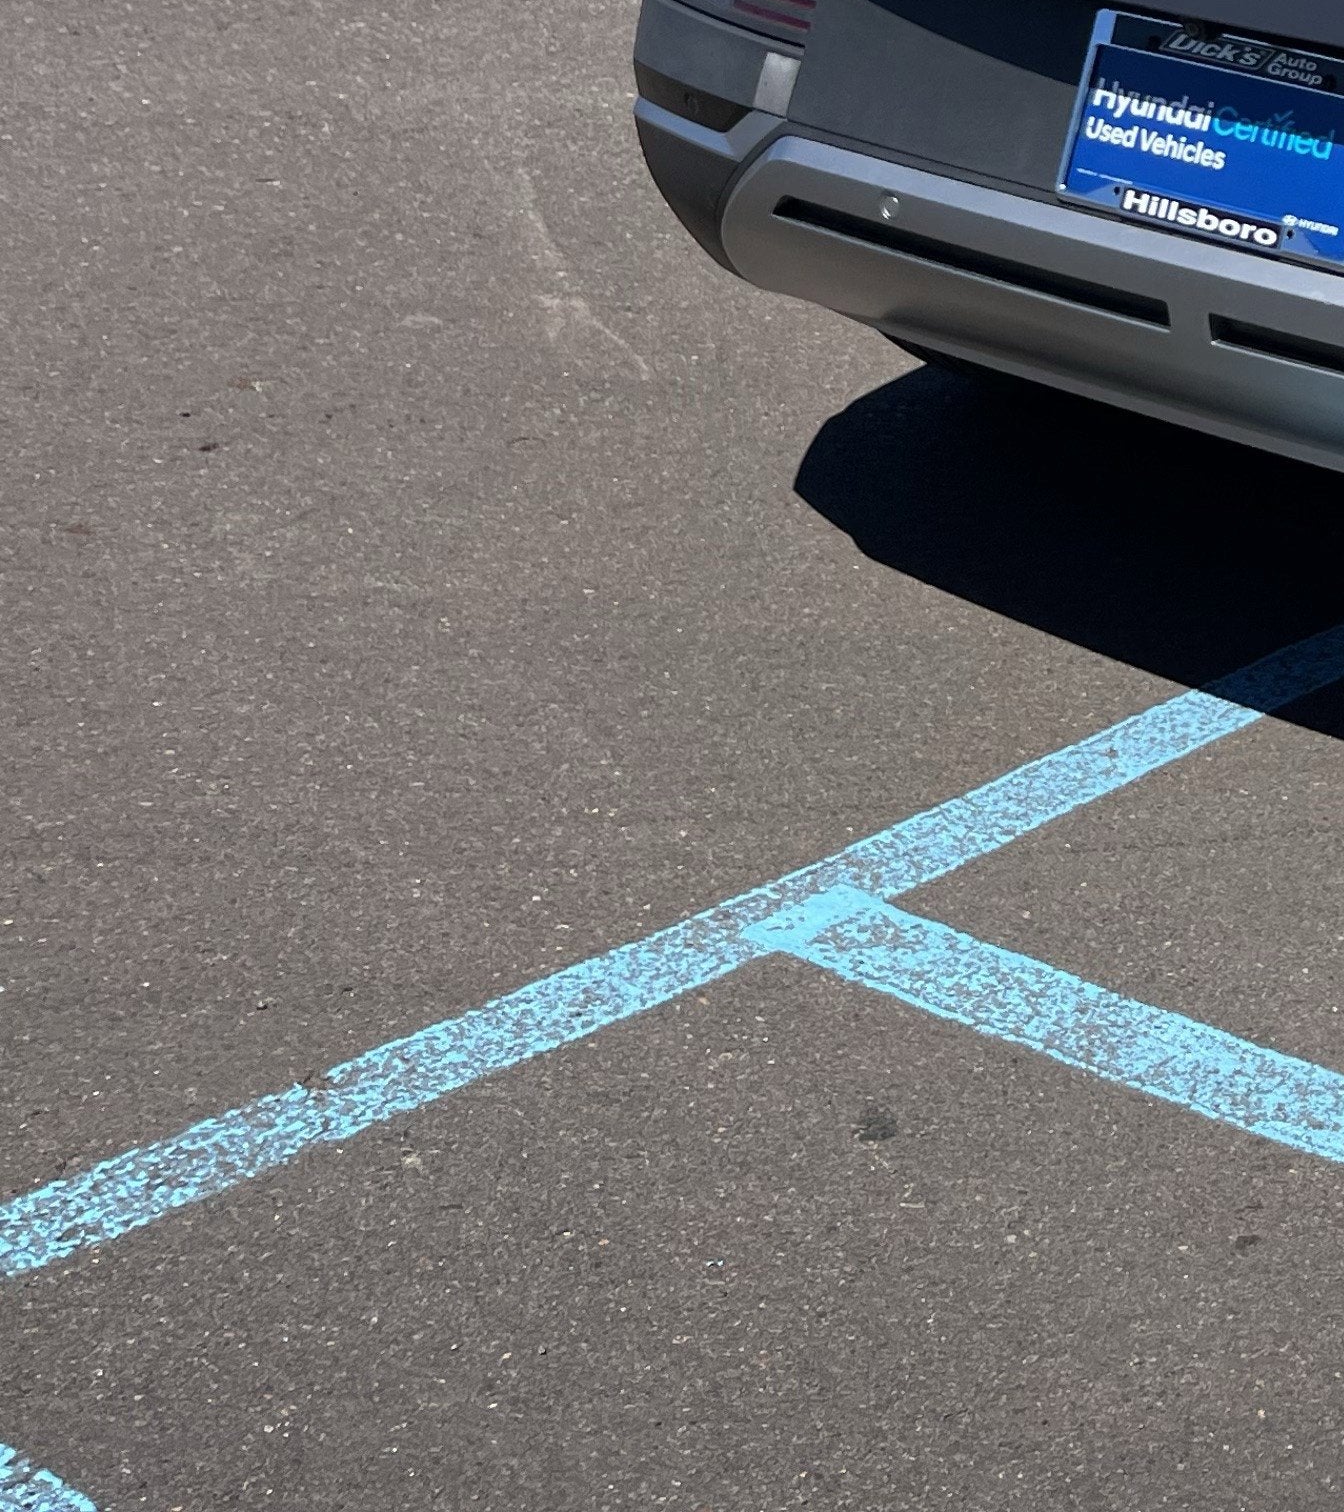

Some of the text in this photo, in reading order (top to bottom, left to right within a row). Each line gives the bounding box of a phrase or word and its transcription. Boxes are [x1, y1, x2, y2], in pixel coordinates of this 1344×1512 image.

[1266, 63, 1323, 86] Group
[1273, 52, 1318, 72] Auto
[1085, 116, 1227, 170] Used Vehicles
[1092, 77, 1336, 161] Hyundai Certified
[1122, 189, 1278, 246] Hillsboro
